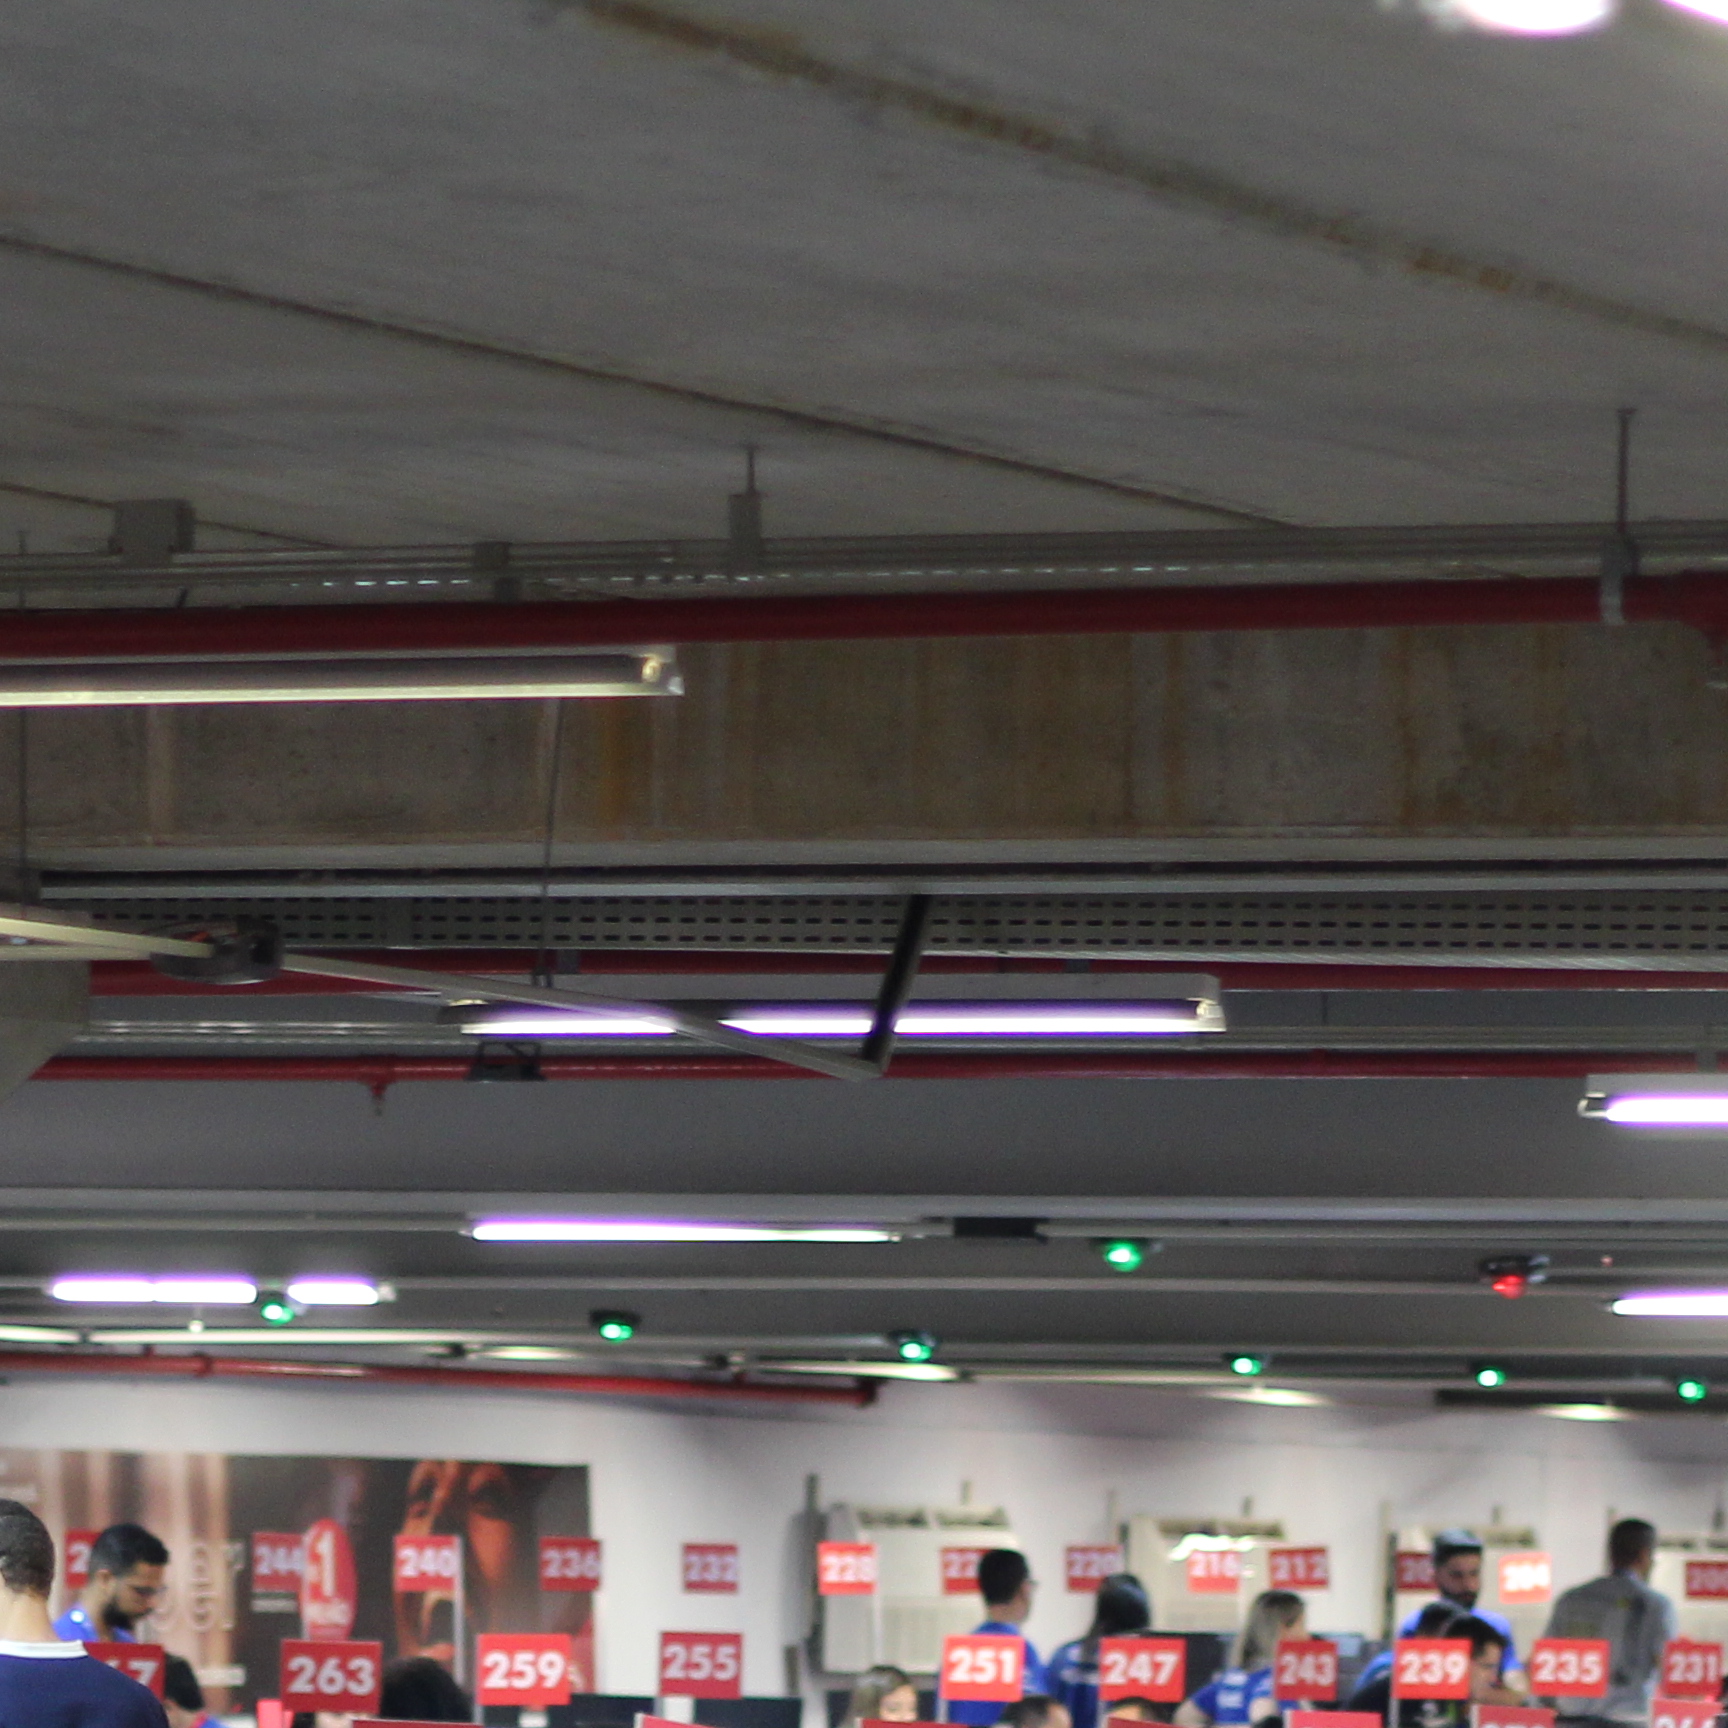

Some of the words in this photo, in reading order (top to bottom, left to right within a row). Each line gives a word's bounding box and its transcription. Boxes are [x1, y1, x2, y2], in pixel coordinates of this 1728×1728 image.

[398, 1548, 456, 1578] 240
[944, 1552, 978, 1578] 22
[288, 1656, 376, 1695] 263
[482, 1651, 567, 1689] 259
[662, 1643, 739, 1681] 255
[948, 1647, 1016, 1684] 251
[1103, 1650, 1178, 1686] 247
[1279, 1652, 1335, 1686] 243
[1400, 1651, 1468, 1685] 239
[1534, 1650, 1603, 1685] 235
[1668, 1652, 1718, 1684] 231
